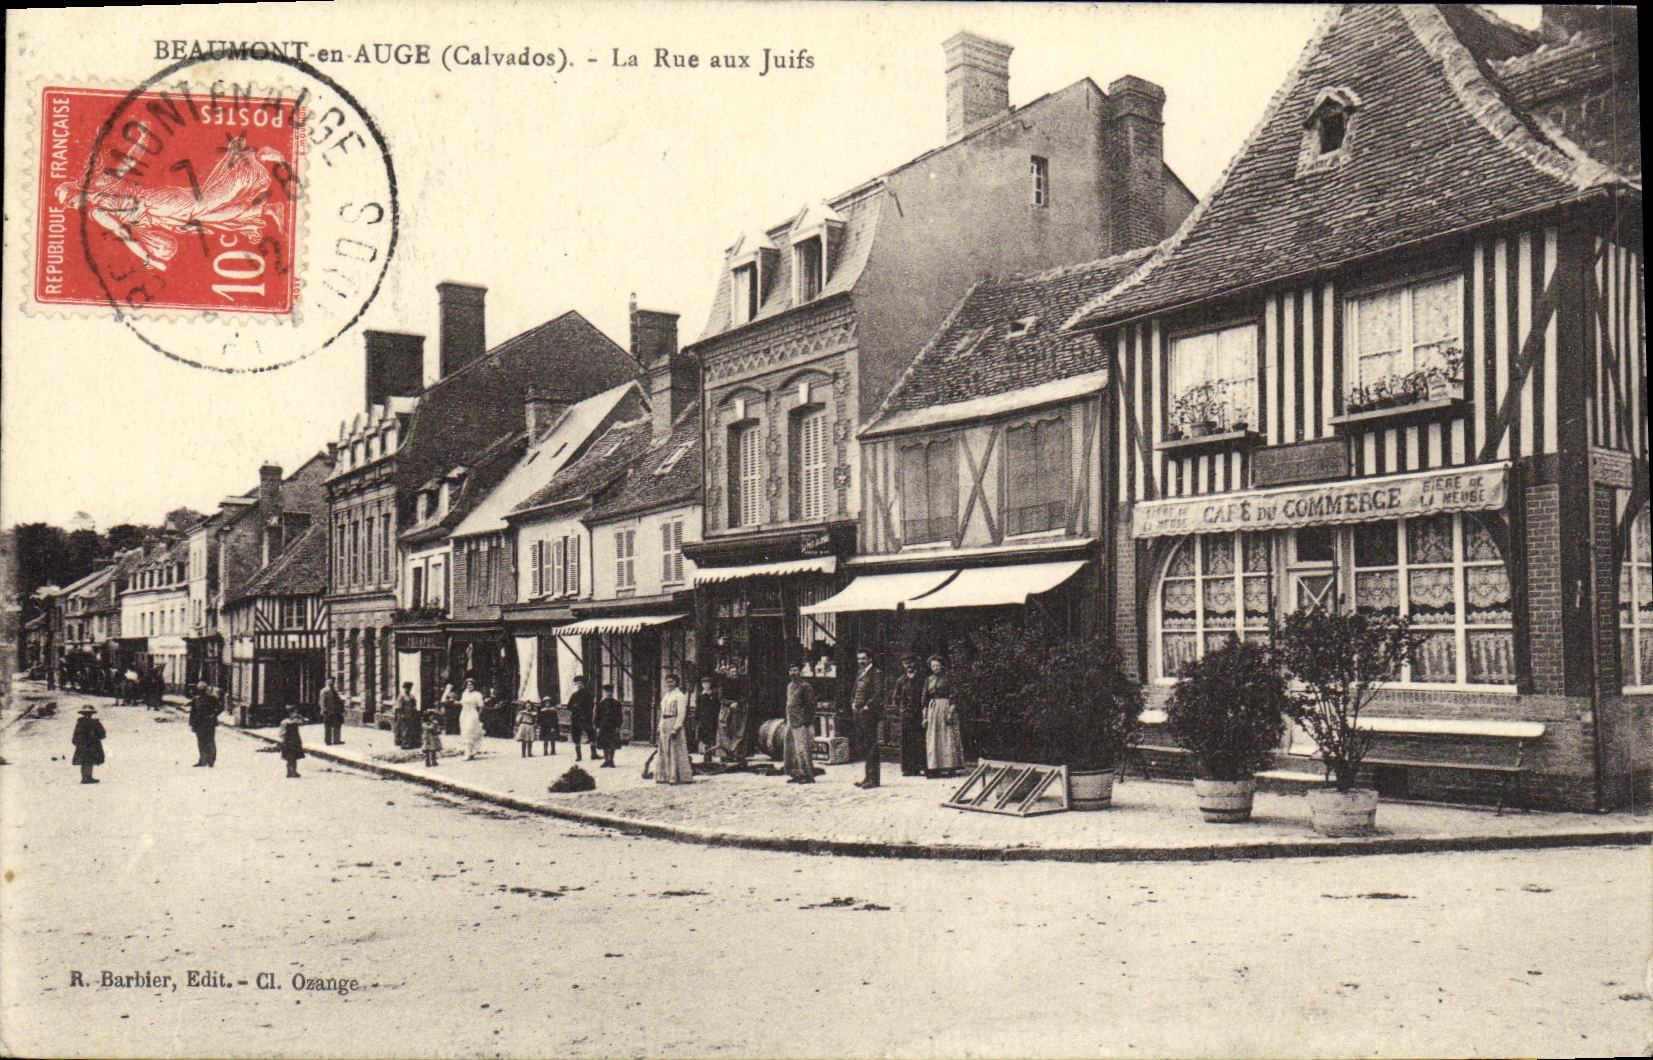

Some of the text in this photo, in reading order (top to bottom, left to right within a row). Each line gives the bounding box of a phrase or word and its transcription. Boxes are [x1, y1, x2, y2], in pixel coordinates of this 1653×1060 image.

[200, 105, 284, 128] POSTES
[51, 97, 70, 179] FRANÇAISE
[1203, 487, 1401, 524] CAFÉ DU COMMERCE
[1443, 489, 1486, 504] MEUSE
